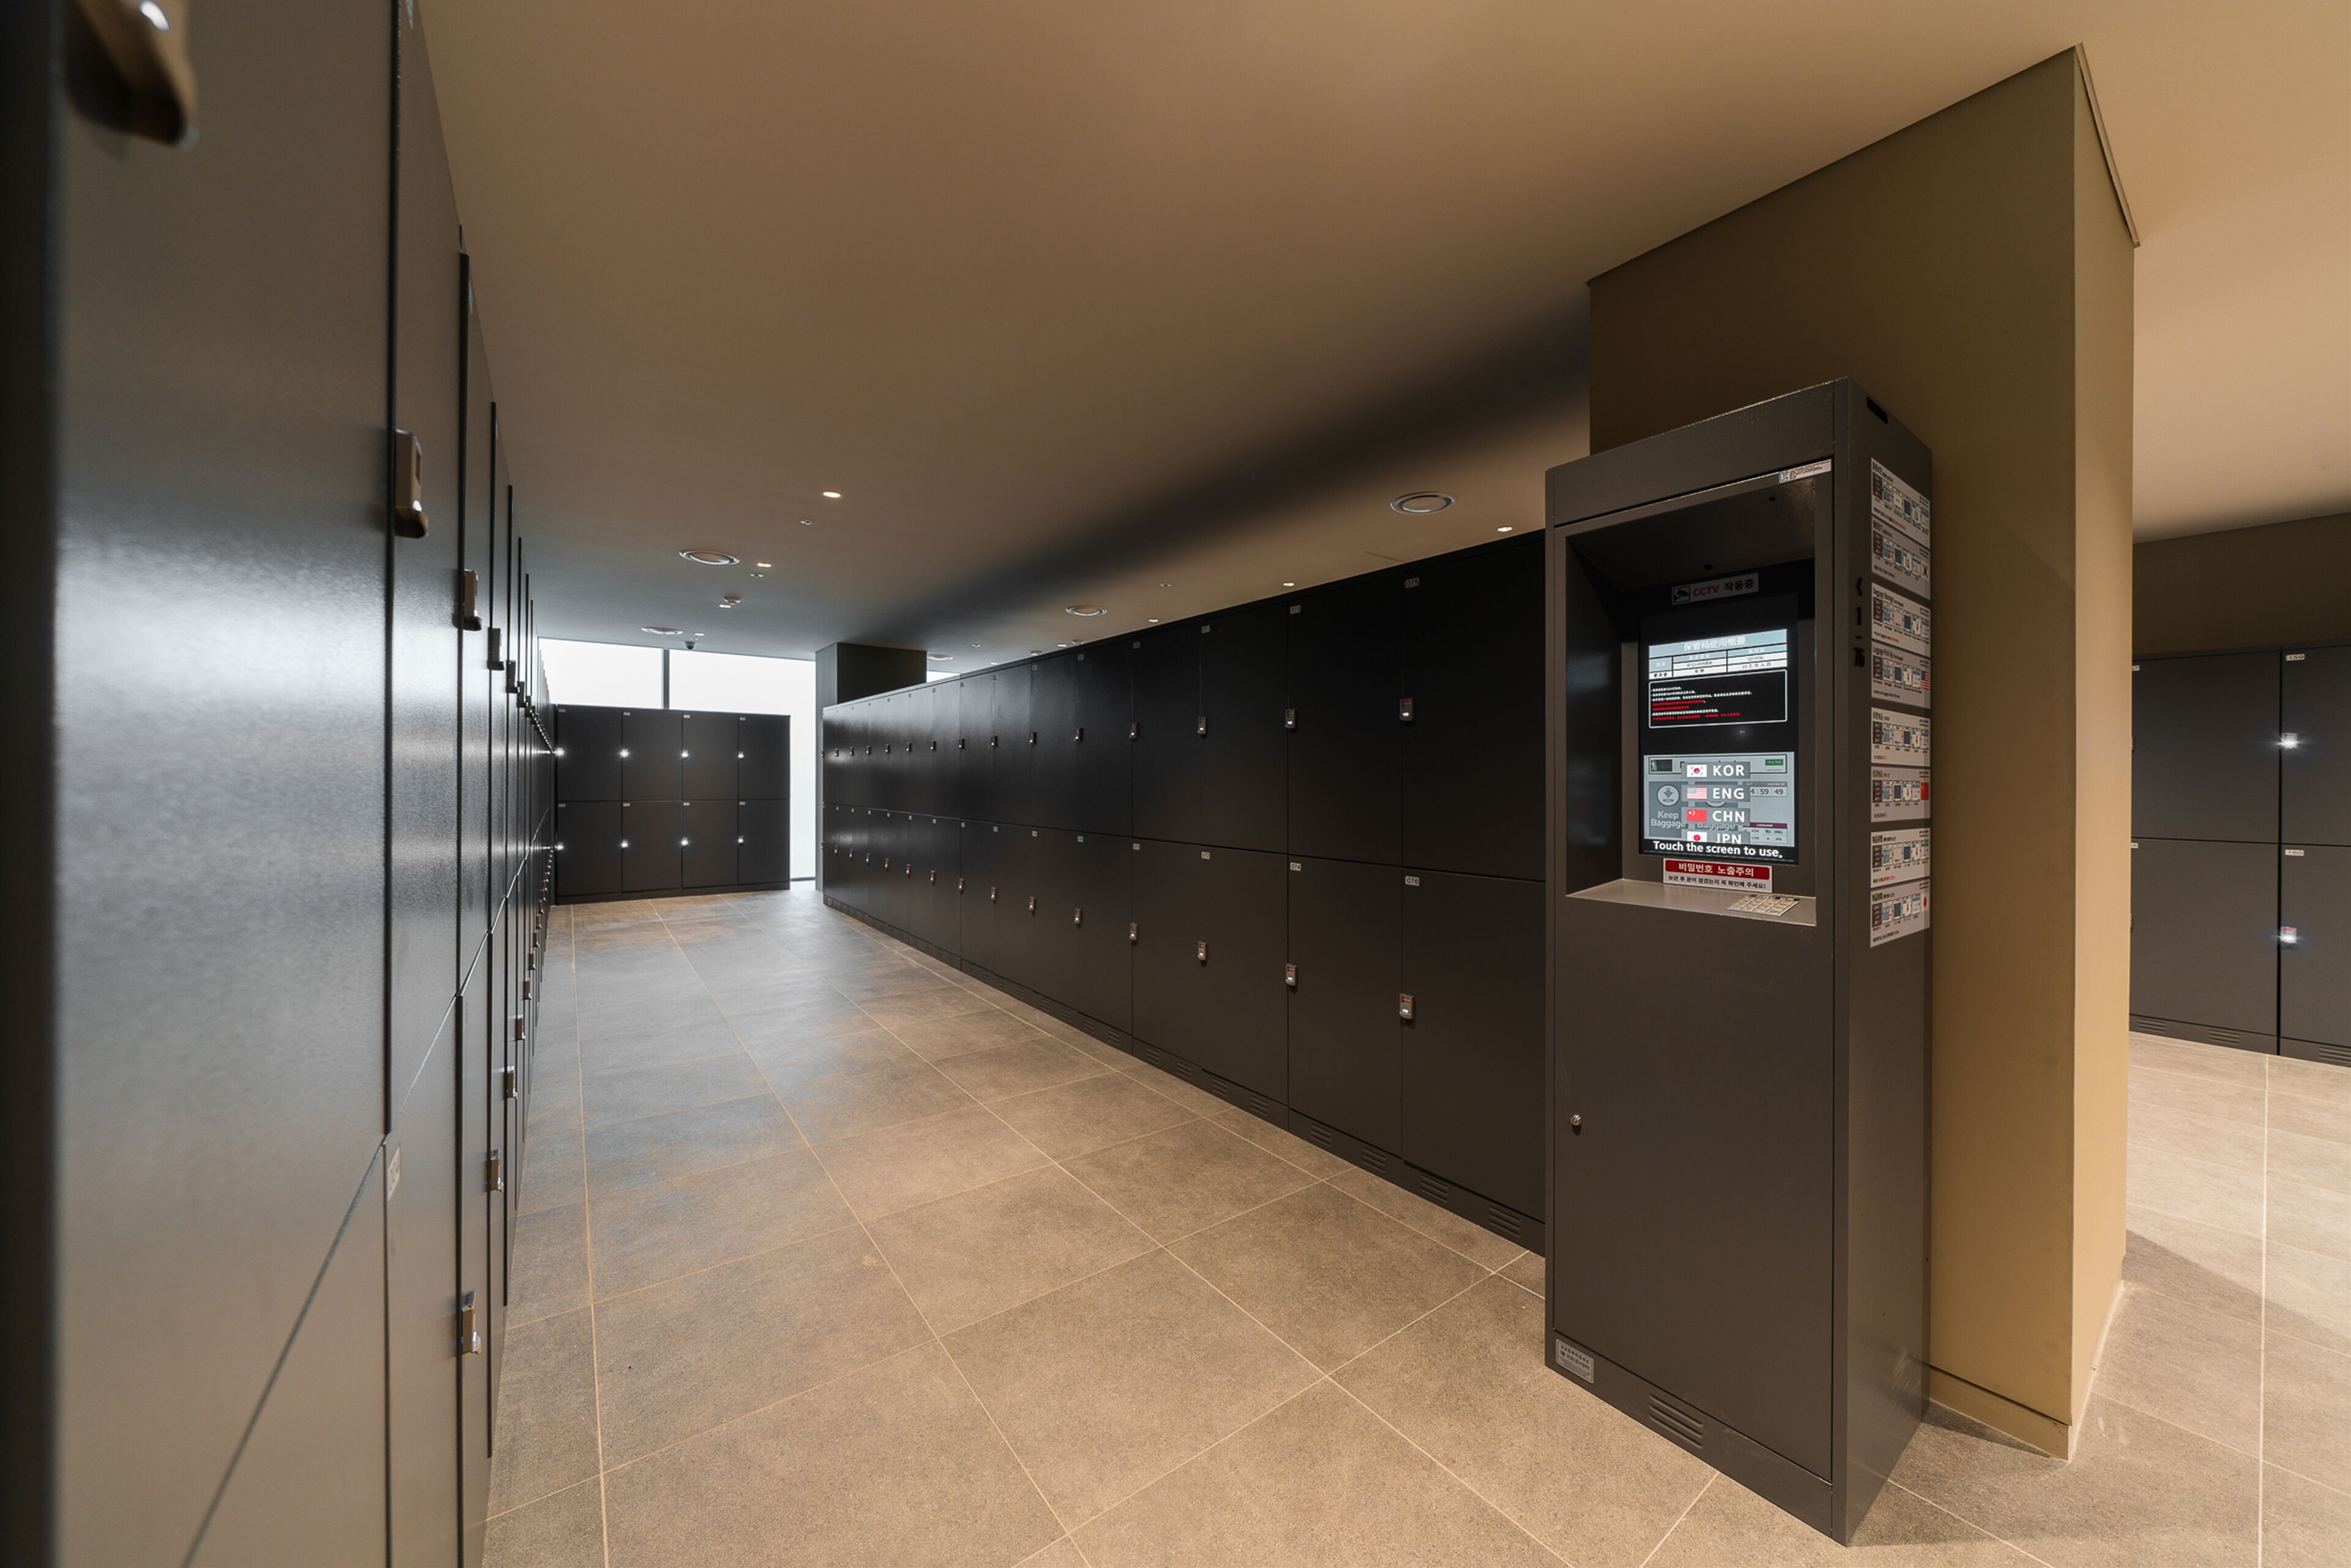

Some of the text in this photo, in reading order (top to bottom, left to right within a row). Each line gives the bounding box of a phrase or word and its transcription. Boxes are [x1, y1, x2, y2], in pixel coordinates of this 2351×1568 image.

[1693, 579, 1754, 596] CCTV 작동중
[1713, 765, 1745, 776] KOR
[1712, 788, 1744, 800] ENG
[1657, 811, 1679, 820] Keep
[1712, 810, 1745, 822] CHN
[1651, 819, 1686, 829] Baggage
[1715, 833, 1742, 844] JPN
[1653, 841, 1783, 858] Touch the screen to use.
[1679, 863, 1754, 877] 비밀번호 노출주의
